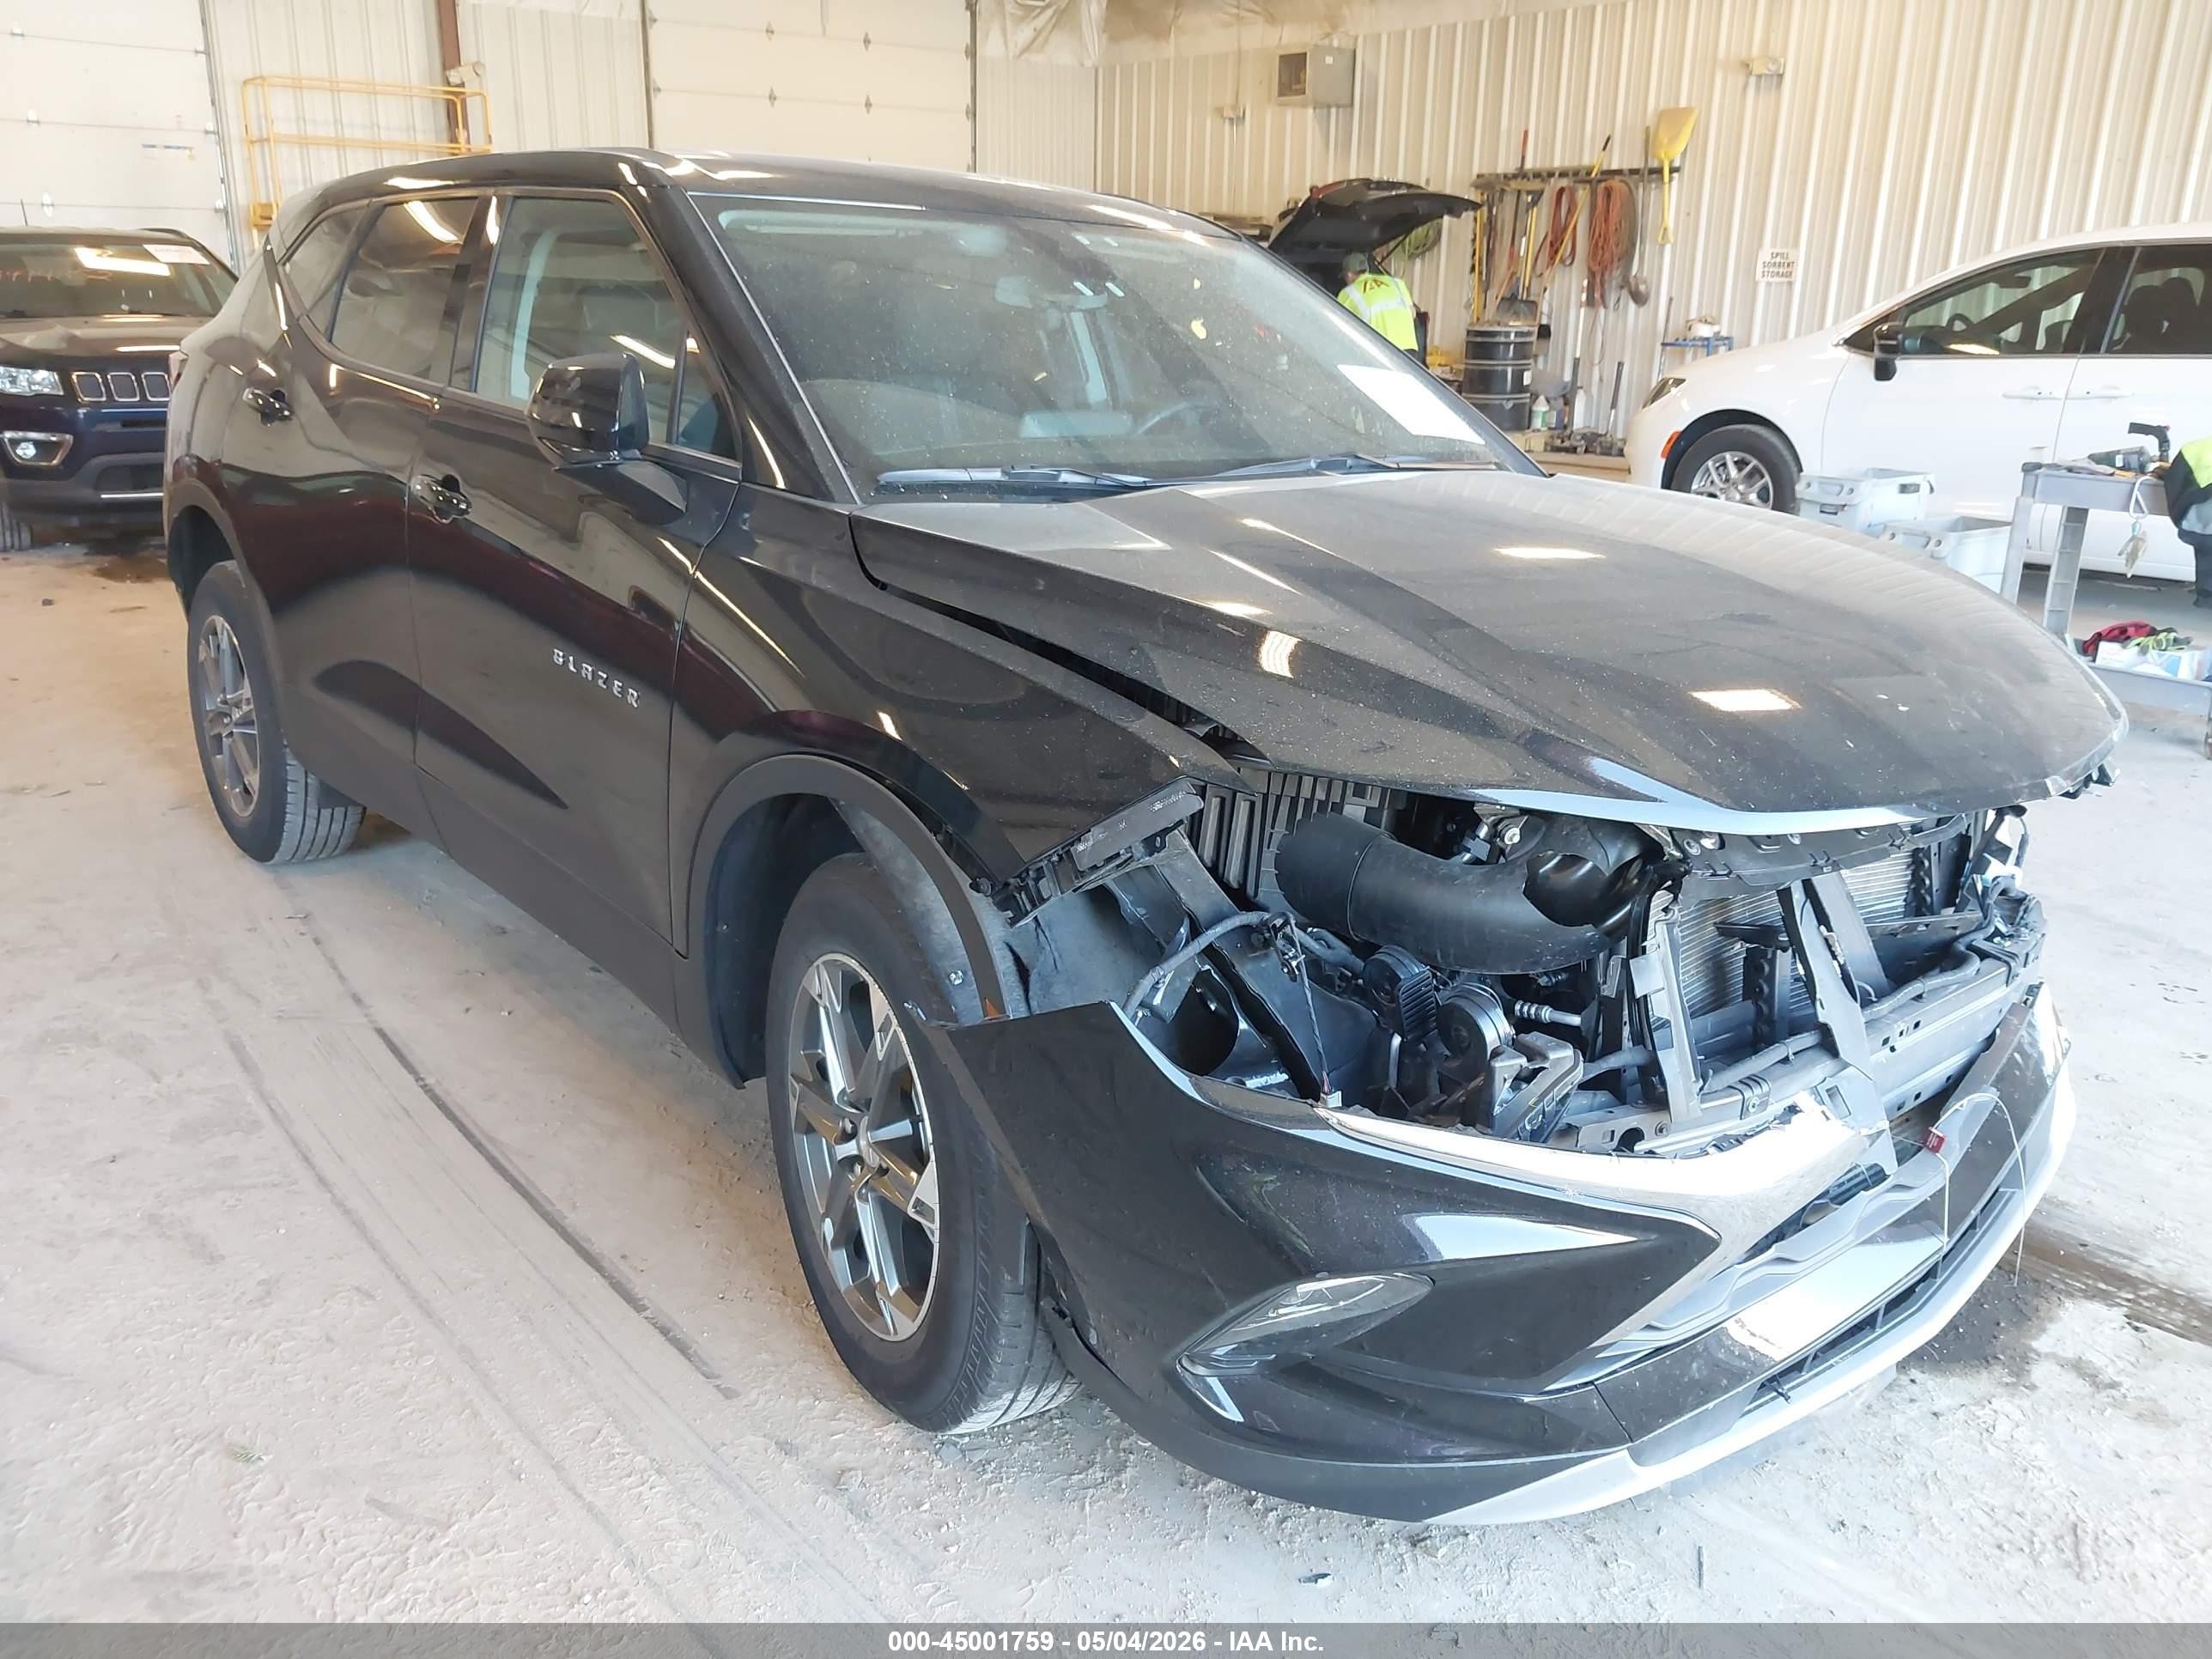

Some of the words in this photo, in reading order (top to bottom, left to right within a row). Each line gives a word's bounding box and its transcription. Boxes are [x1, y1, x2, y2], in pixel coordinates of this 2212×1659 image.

[1771, 252, 1789, 260] SPILL
[1760, 270, 1794, 279] STORAGE
[552, 648, 641, 708] BLAZER
